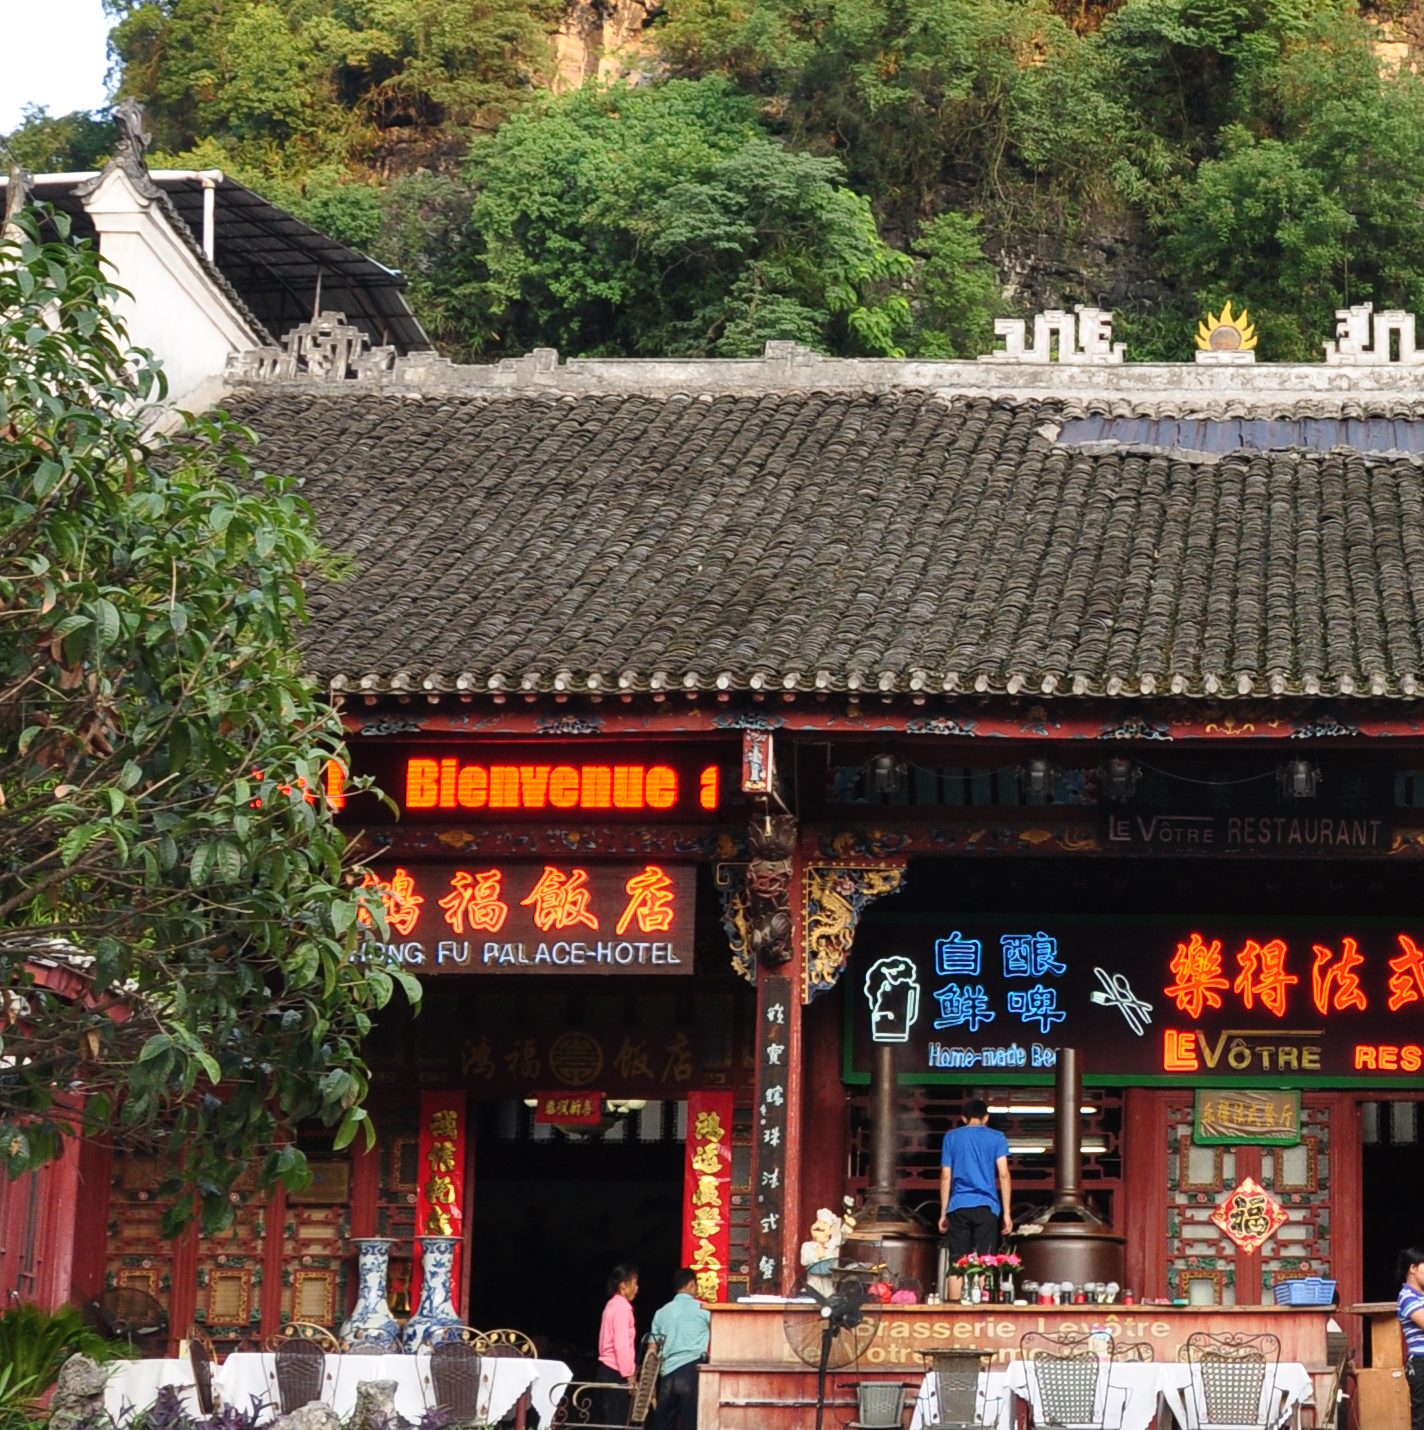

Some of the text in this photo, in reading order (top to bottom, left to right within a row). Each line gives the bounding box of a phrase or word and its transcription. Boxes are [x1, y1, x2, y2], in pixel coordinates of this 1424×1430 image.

[406, 757, 678, 809] Bienvenue
[1109, 816, 1131, 841] LE
[1228, 817, 1381, 846] RESTAURANT
[437, 941, 471, 965] FU
[483, 941, 682, 965] PALACE-HOTEL
[928, 1042, 1028, 1068] Home-made
[1230, 1194, 1271, 1238] 福
